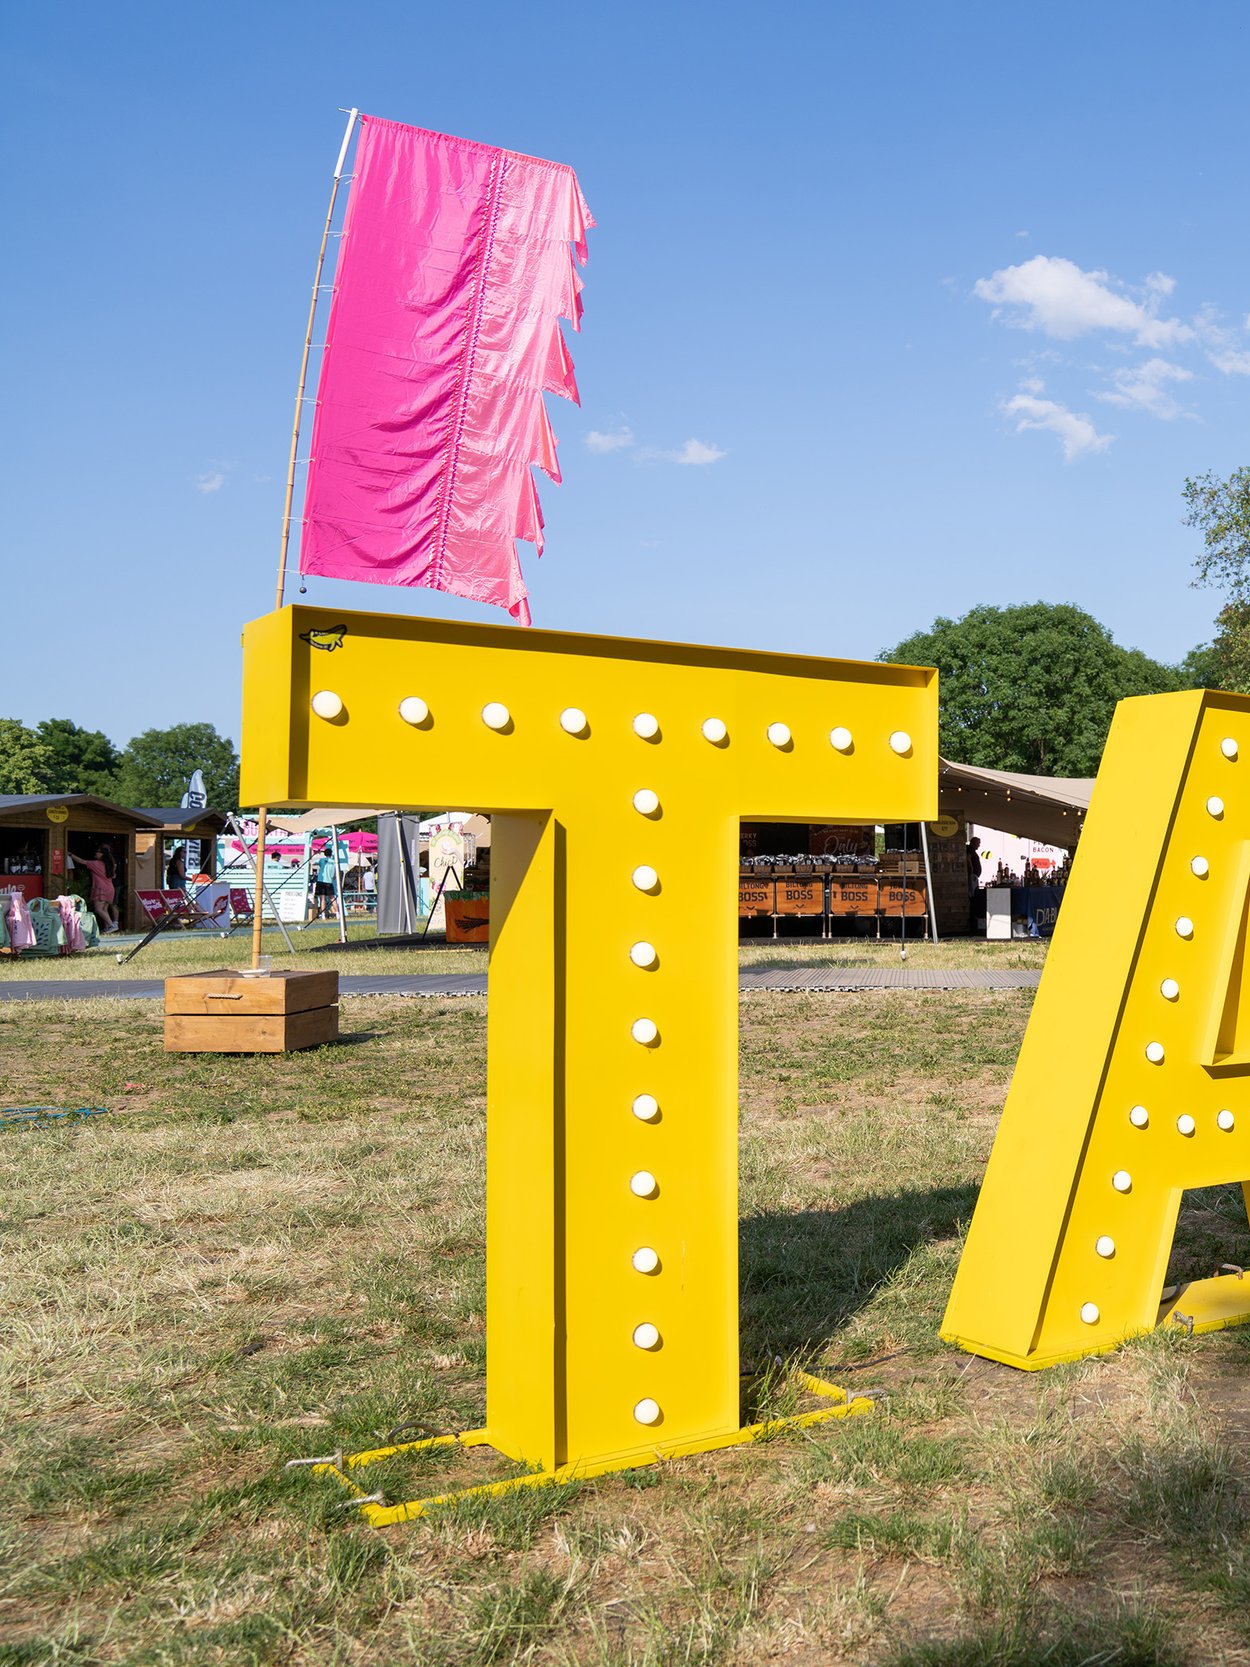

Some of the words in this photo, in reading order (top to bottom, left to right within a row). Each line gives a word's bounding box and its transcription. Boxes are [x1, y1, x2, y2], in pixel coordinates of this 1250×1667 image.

[739, 892, 764, 902] BOSS
[786, 890, 813, 900] BOSS
[841, 891, 868, 901] BOSS
[889, 891, 916, 902] BOSS
